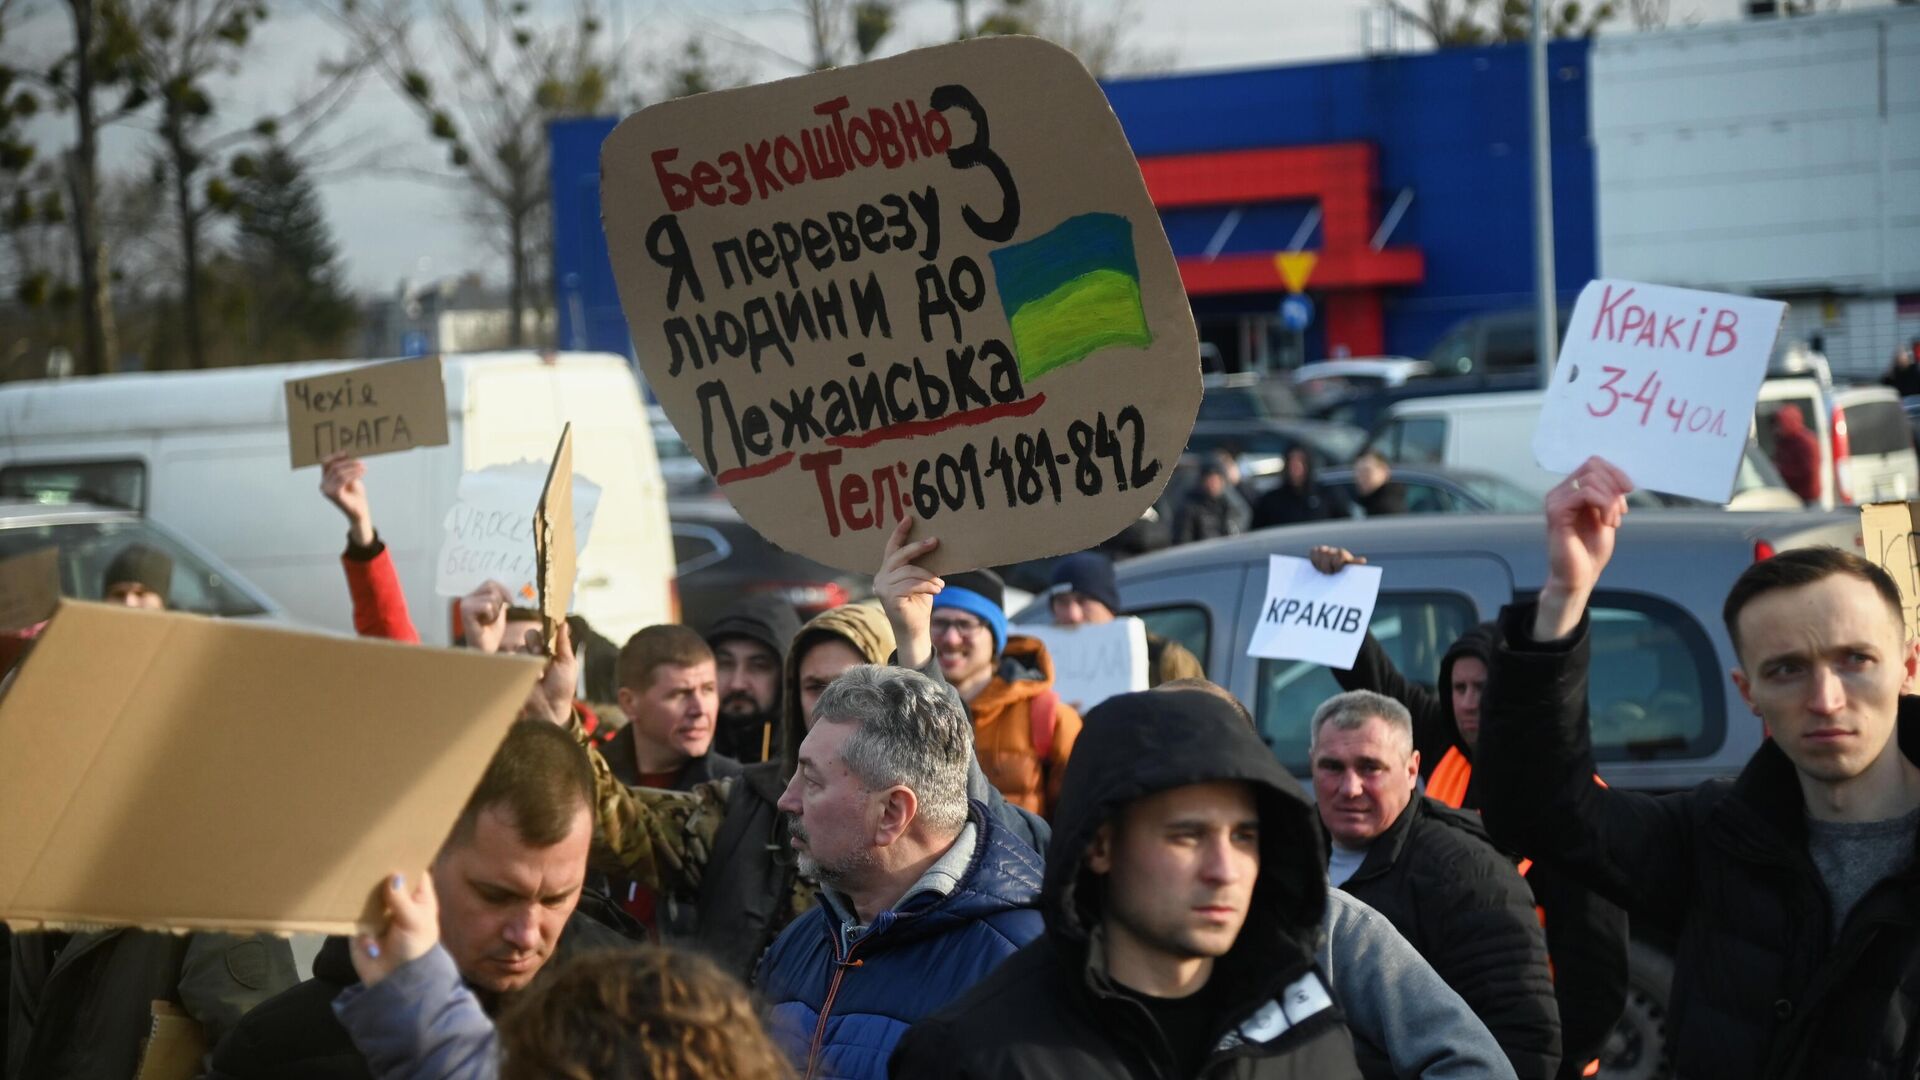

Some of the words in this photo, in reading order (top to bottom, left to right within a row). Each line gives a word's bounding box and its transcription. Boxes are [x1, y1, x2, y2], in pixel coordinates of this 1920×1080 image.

[651, 97, 953, 211] Безкоштовно
[645, 214, 705, 311] Я
[713, 186, 941, 290] перевезу
[662, 271, 892, 377] людини
[916, 256, 986, 342] до
[696, 339, 1025, 475] Лежайська
[1586, 366, 1662, 427] 3-4
[1265, 597, 1363, 634] КРАКІВ
